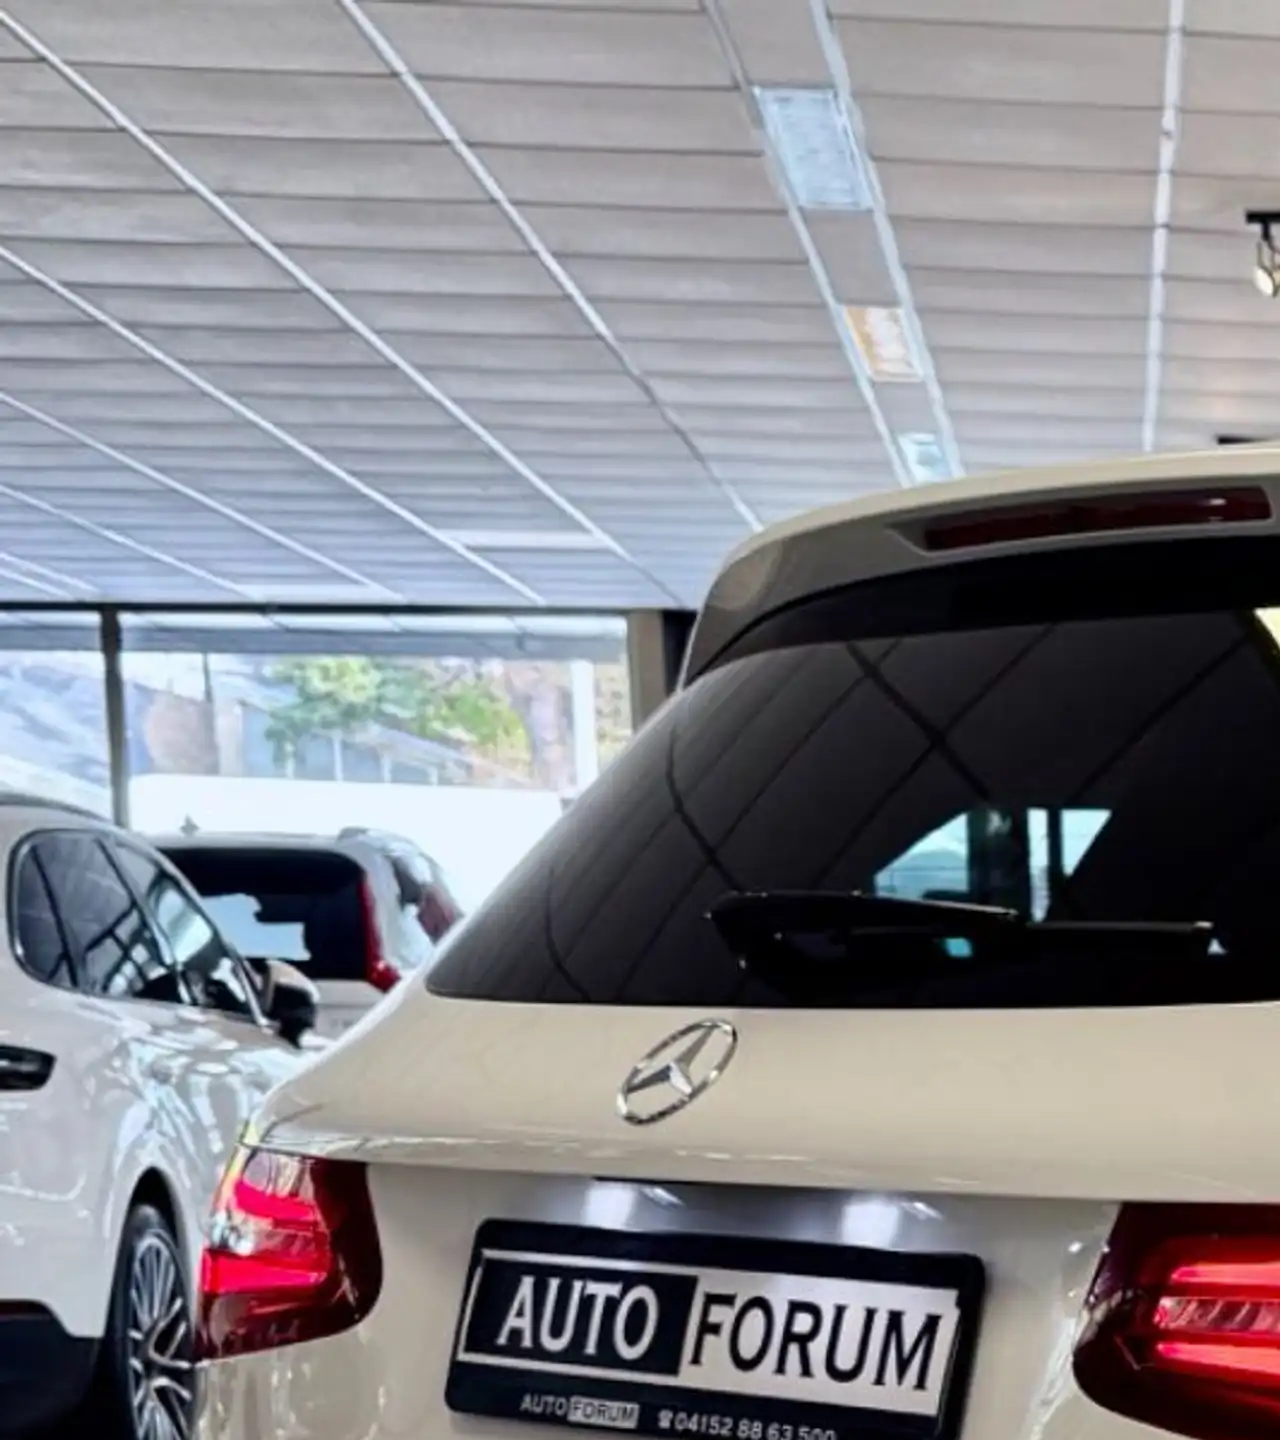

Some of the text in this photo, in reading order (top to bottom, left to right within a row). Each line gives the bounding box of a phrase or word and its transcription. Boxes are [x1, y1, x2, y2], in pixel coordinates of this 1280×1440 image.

[495, 1275, 942, 1391] AUTO FORUM
[674, 1411, 733, 1436] 04152
[736, 1418, 762, 1440] 88
